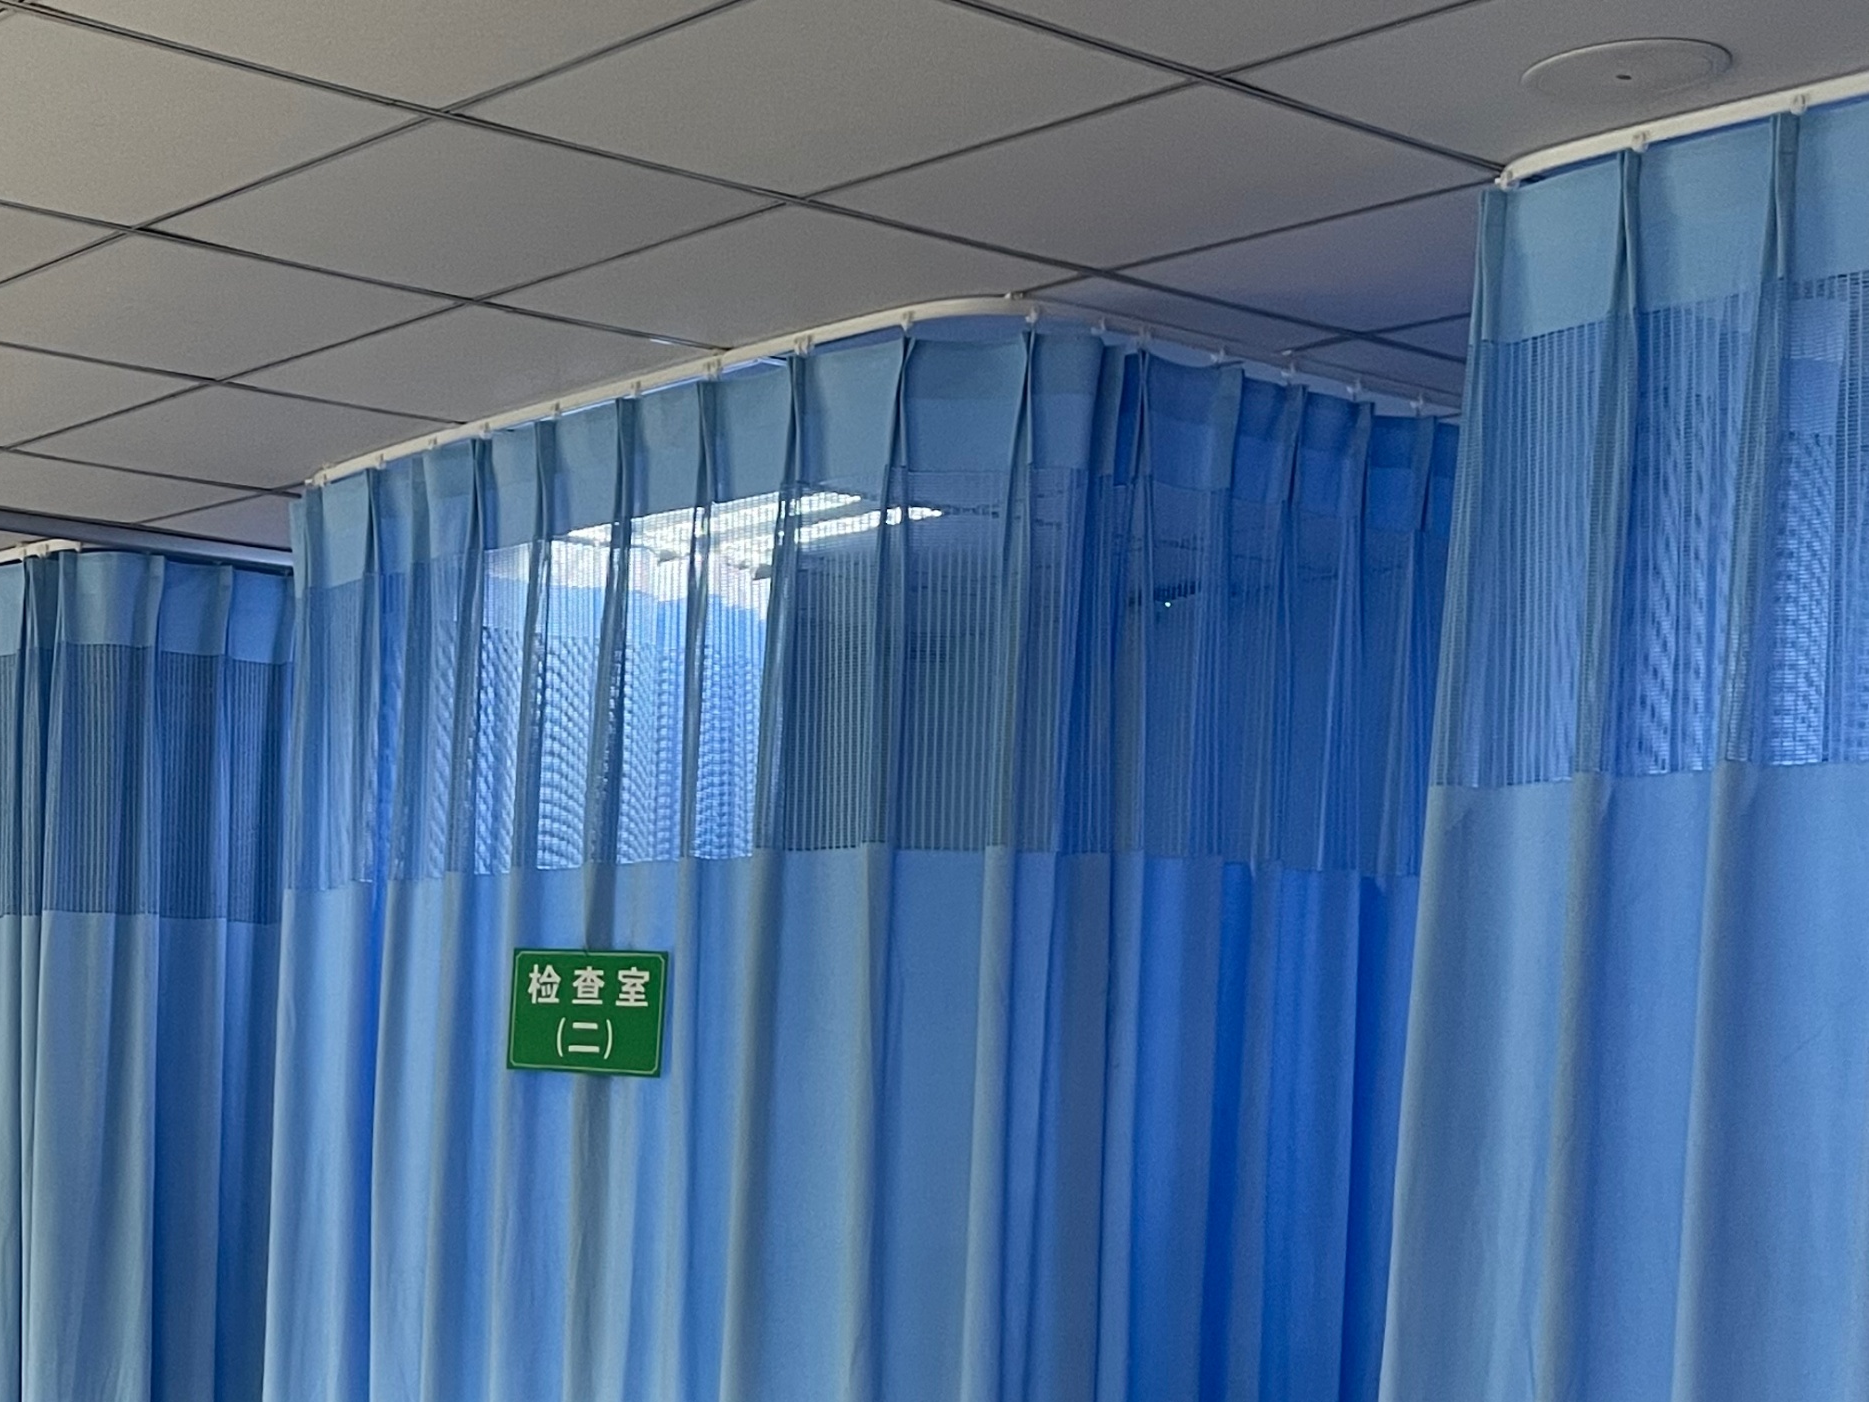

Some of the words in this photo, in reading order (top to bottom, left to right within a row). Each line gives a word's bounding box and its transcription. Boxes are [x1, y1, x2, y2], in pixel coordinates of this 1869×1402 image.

[527, 963, 650, 1008] 检查室
[556, 1016, 613, 1060] (二)
